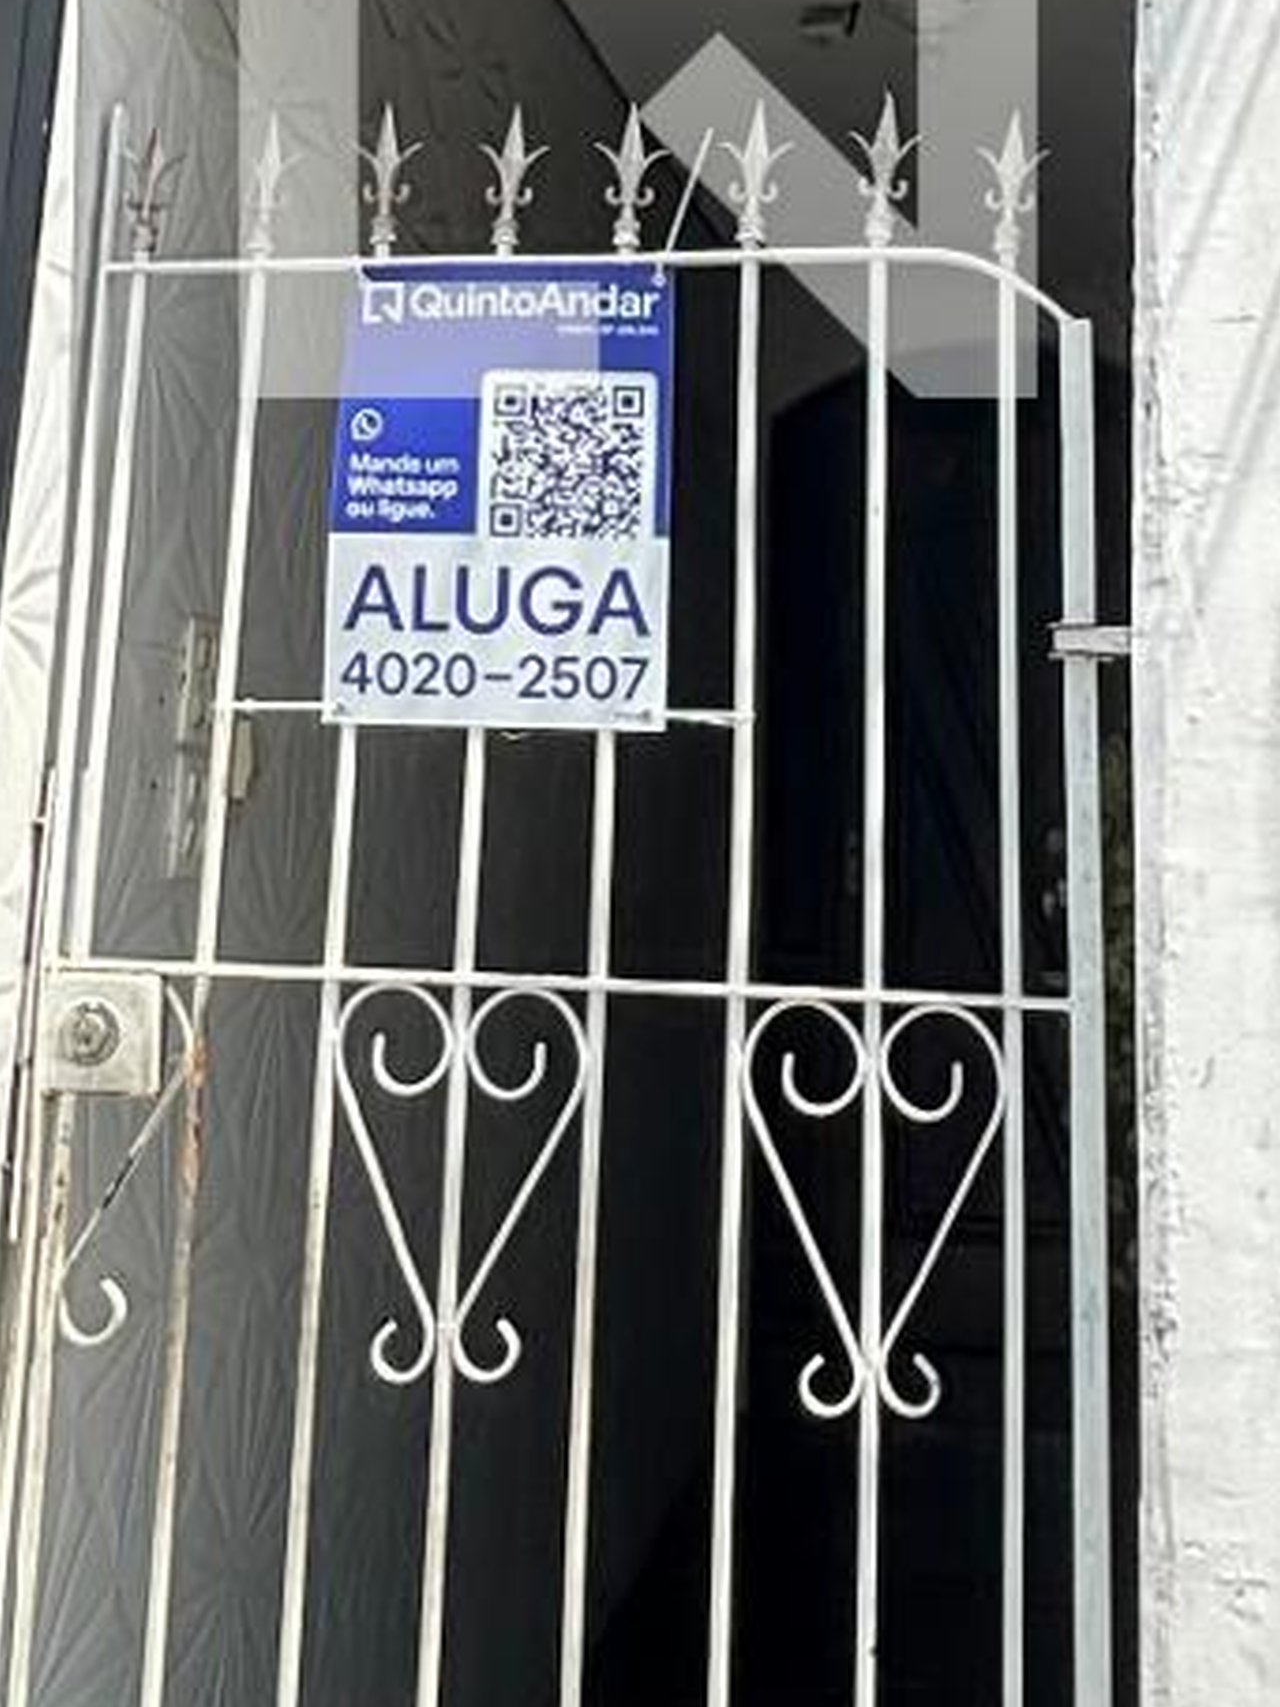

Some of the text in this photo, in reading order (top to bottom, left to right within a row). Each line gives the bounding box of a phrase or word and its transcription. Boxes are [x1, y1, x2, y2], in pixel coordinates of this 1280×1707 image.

[409, 282, 661, 319] QuintoAndar
[350, 453, 460, 475] Mande um
[346, 501, 375, 519] ou
[343, 564, 651, 638] ALUGA
[341, 651, 651, 700] 4020-2507
